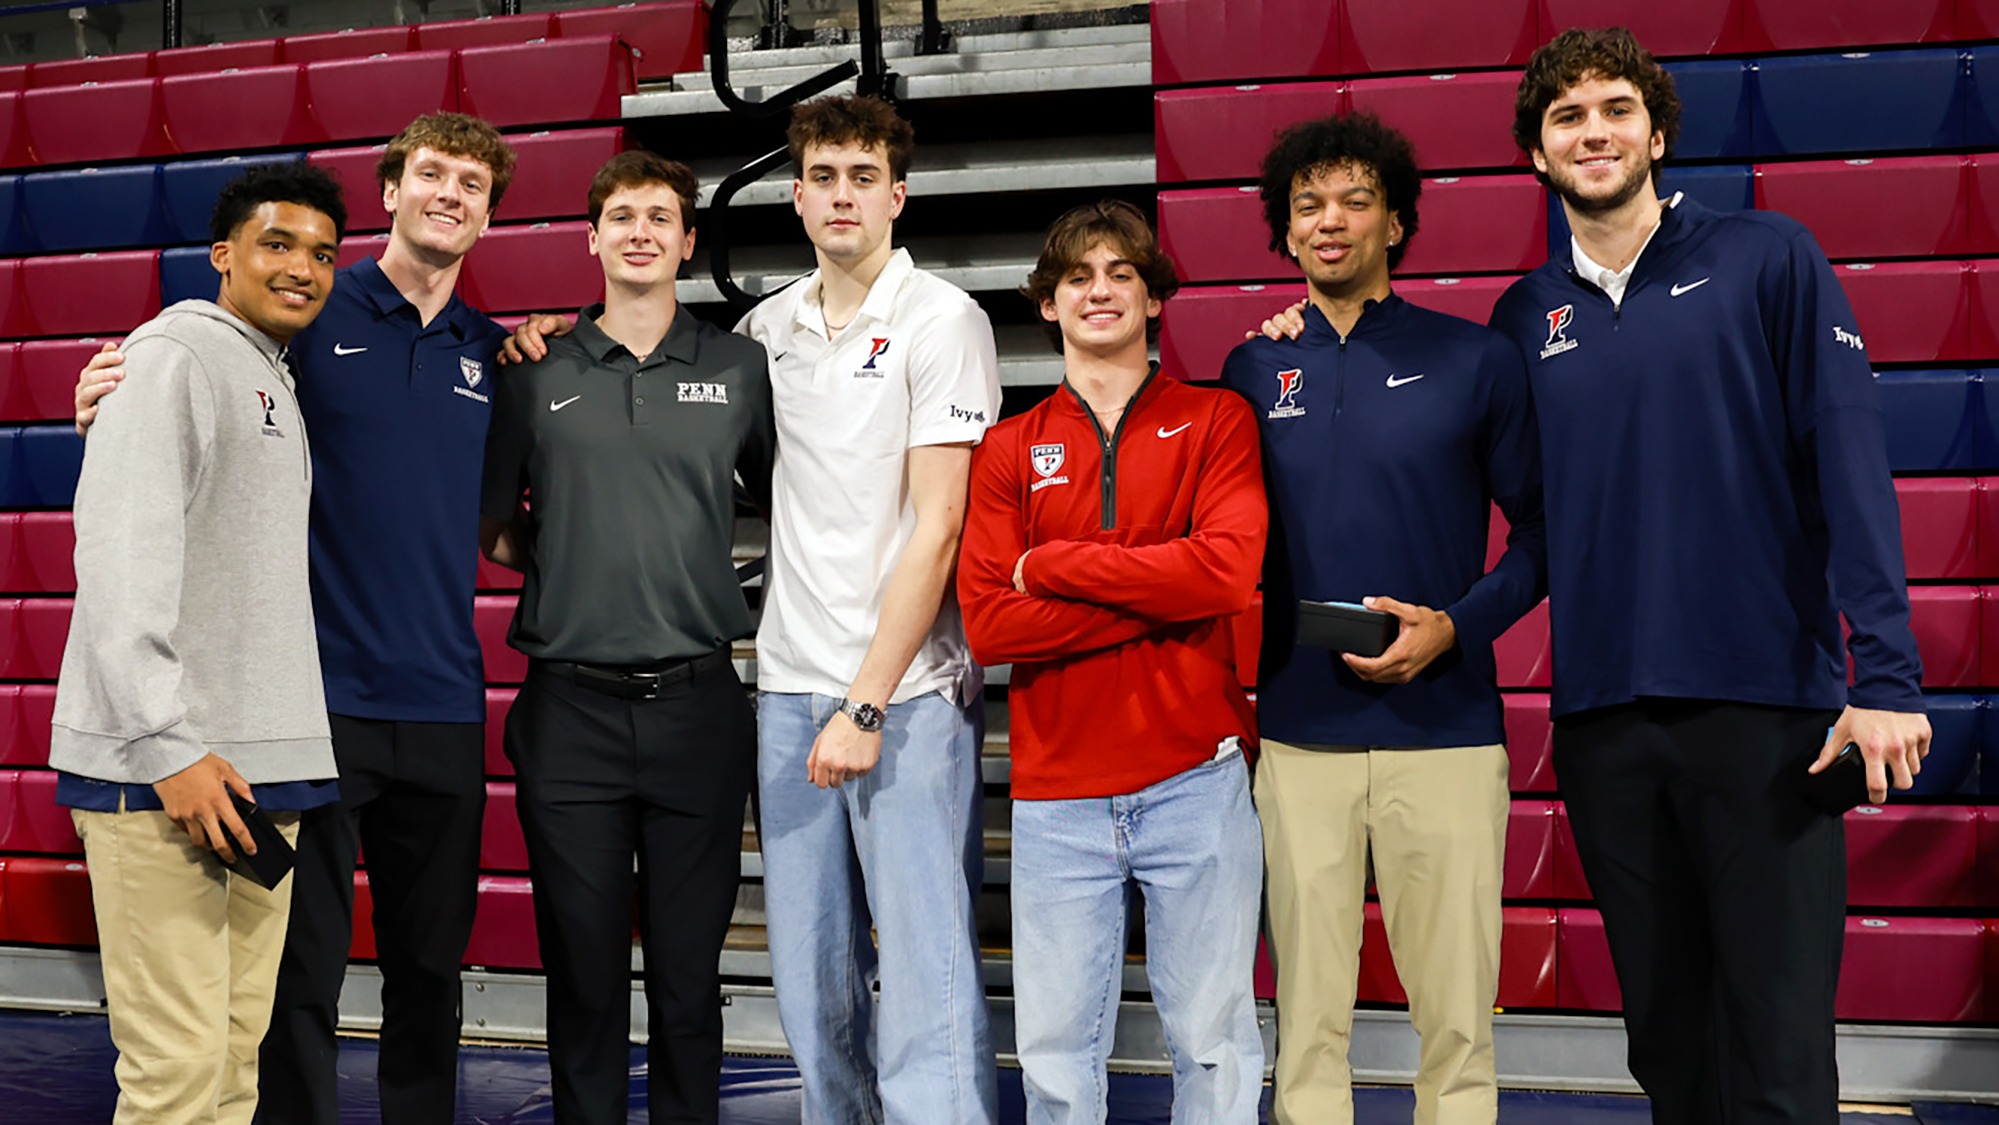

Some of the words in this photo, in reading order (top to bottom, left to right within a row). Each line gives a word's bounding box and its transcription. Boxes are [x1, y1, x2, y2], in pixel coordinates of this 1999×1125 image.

[676, 382, 727, 397] PENN
[677, 394, 729, 404] BASKETBALL
[950, 404, 973, 423] Ivy
[1268, 406, 1306, 419] BASKETBALL
[1034, 447, 1061, 456] PENN
[1030, 475, 1070, 492] BASKETBALL
